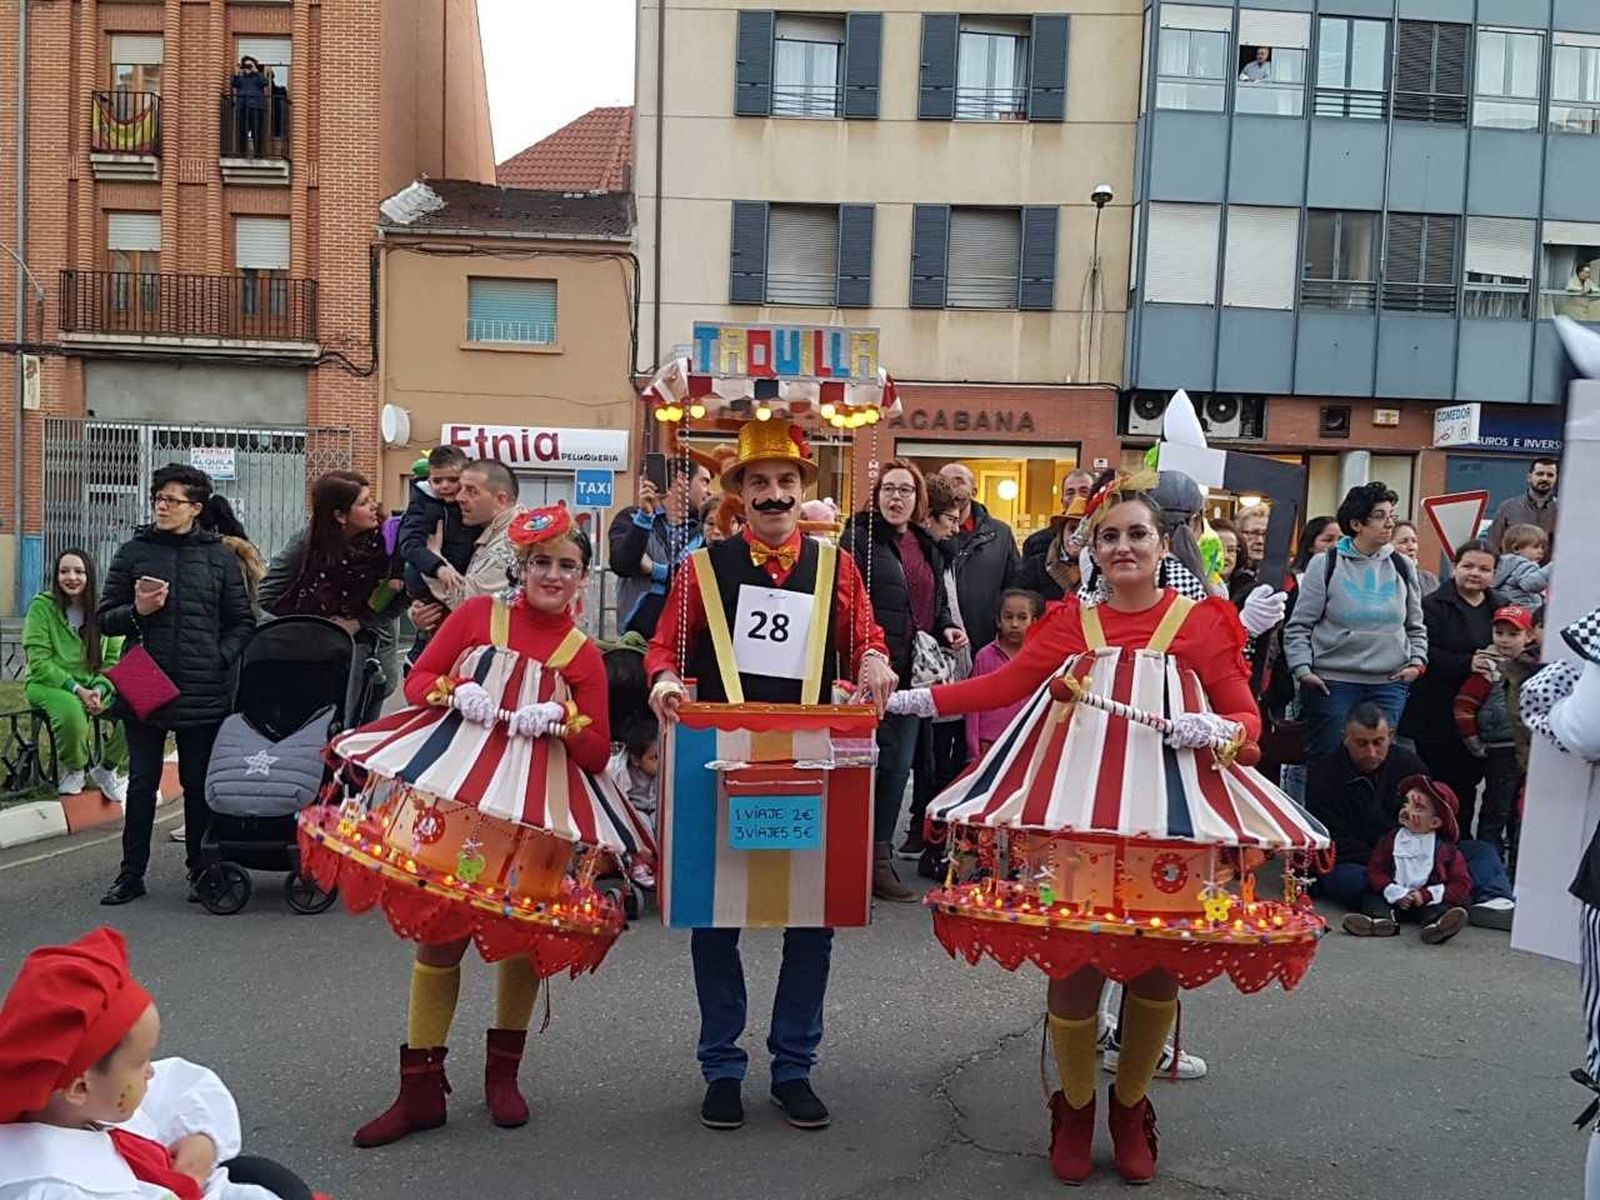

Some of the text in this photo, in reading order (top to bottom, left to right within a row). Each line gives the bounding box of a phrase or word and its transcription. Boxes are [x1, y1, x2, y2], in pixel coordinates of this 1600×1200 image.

[693, 327, 878, 378] TAQUILLA
[1436, 406, 1470, 422] COMEDOR
[451, 425, 560, 463] Etnia
[1512, 438, 1520, 447] E
[578, 481, 611, 495] TAXI
[747, 610, 790, 643] 28
[744, 805, 784, 820] VIAJE
